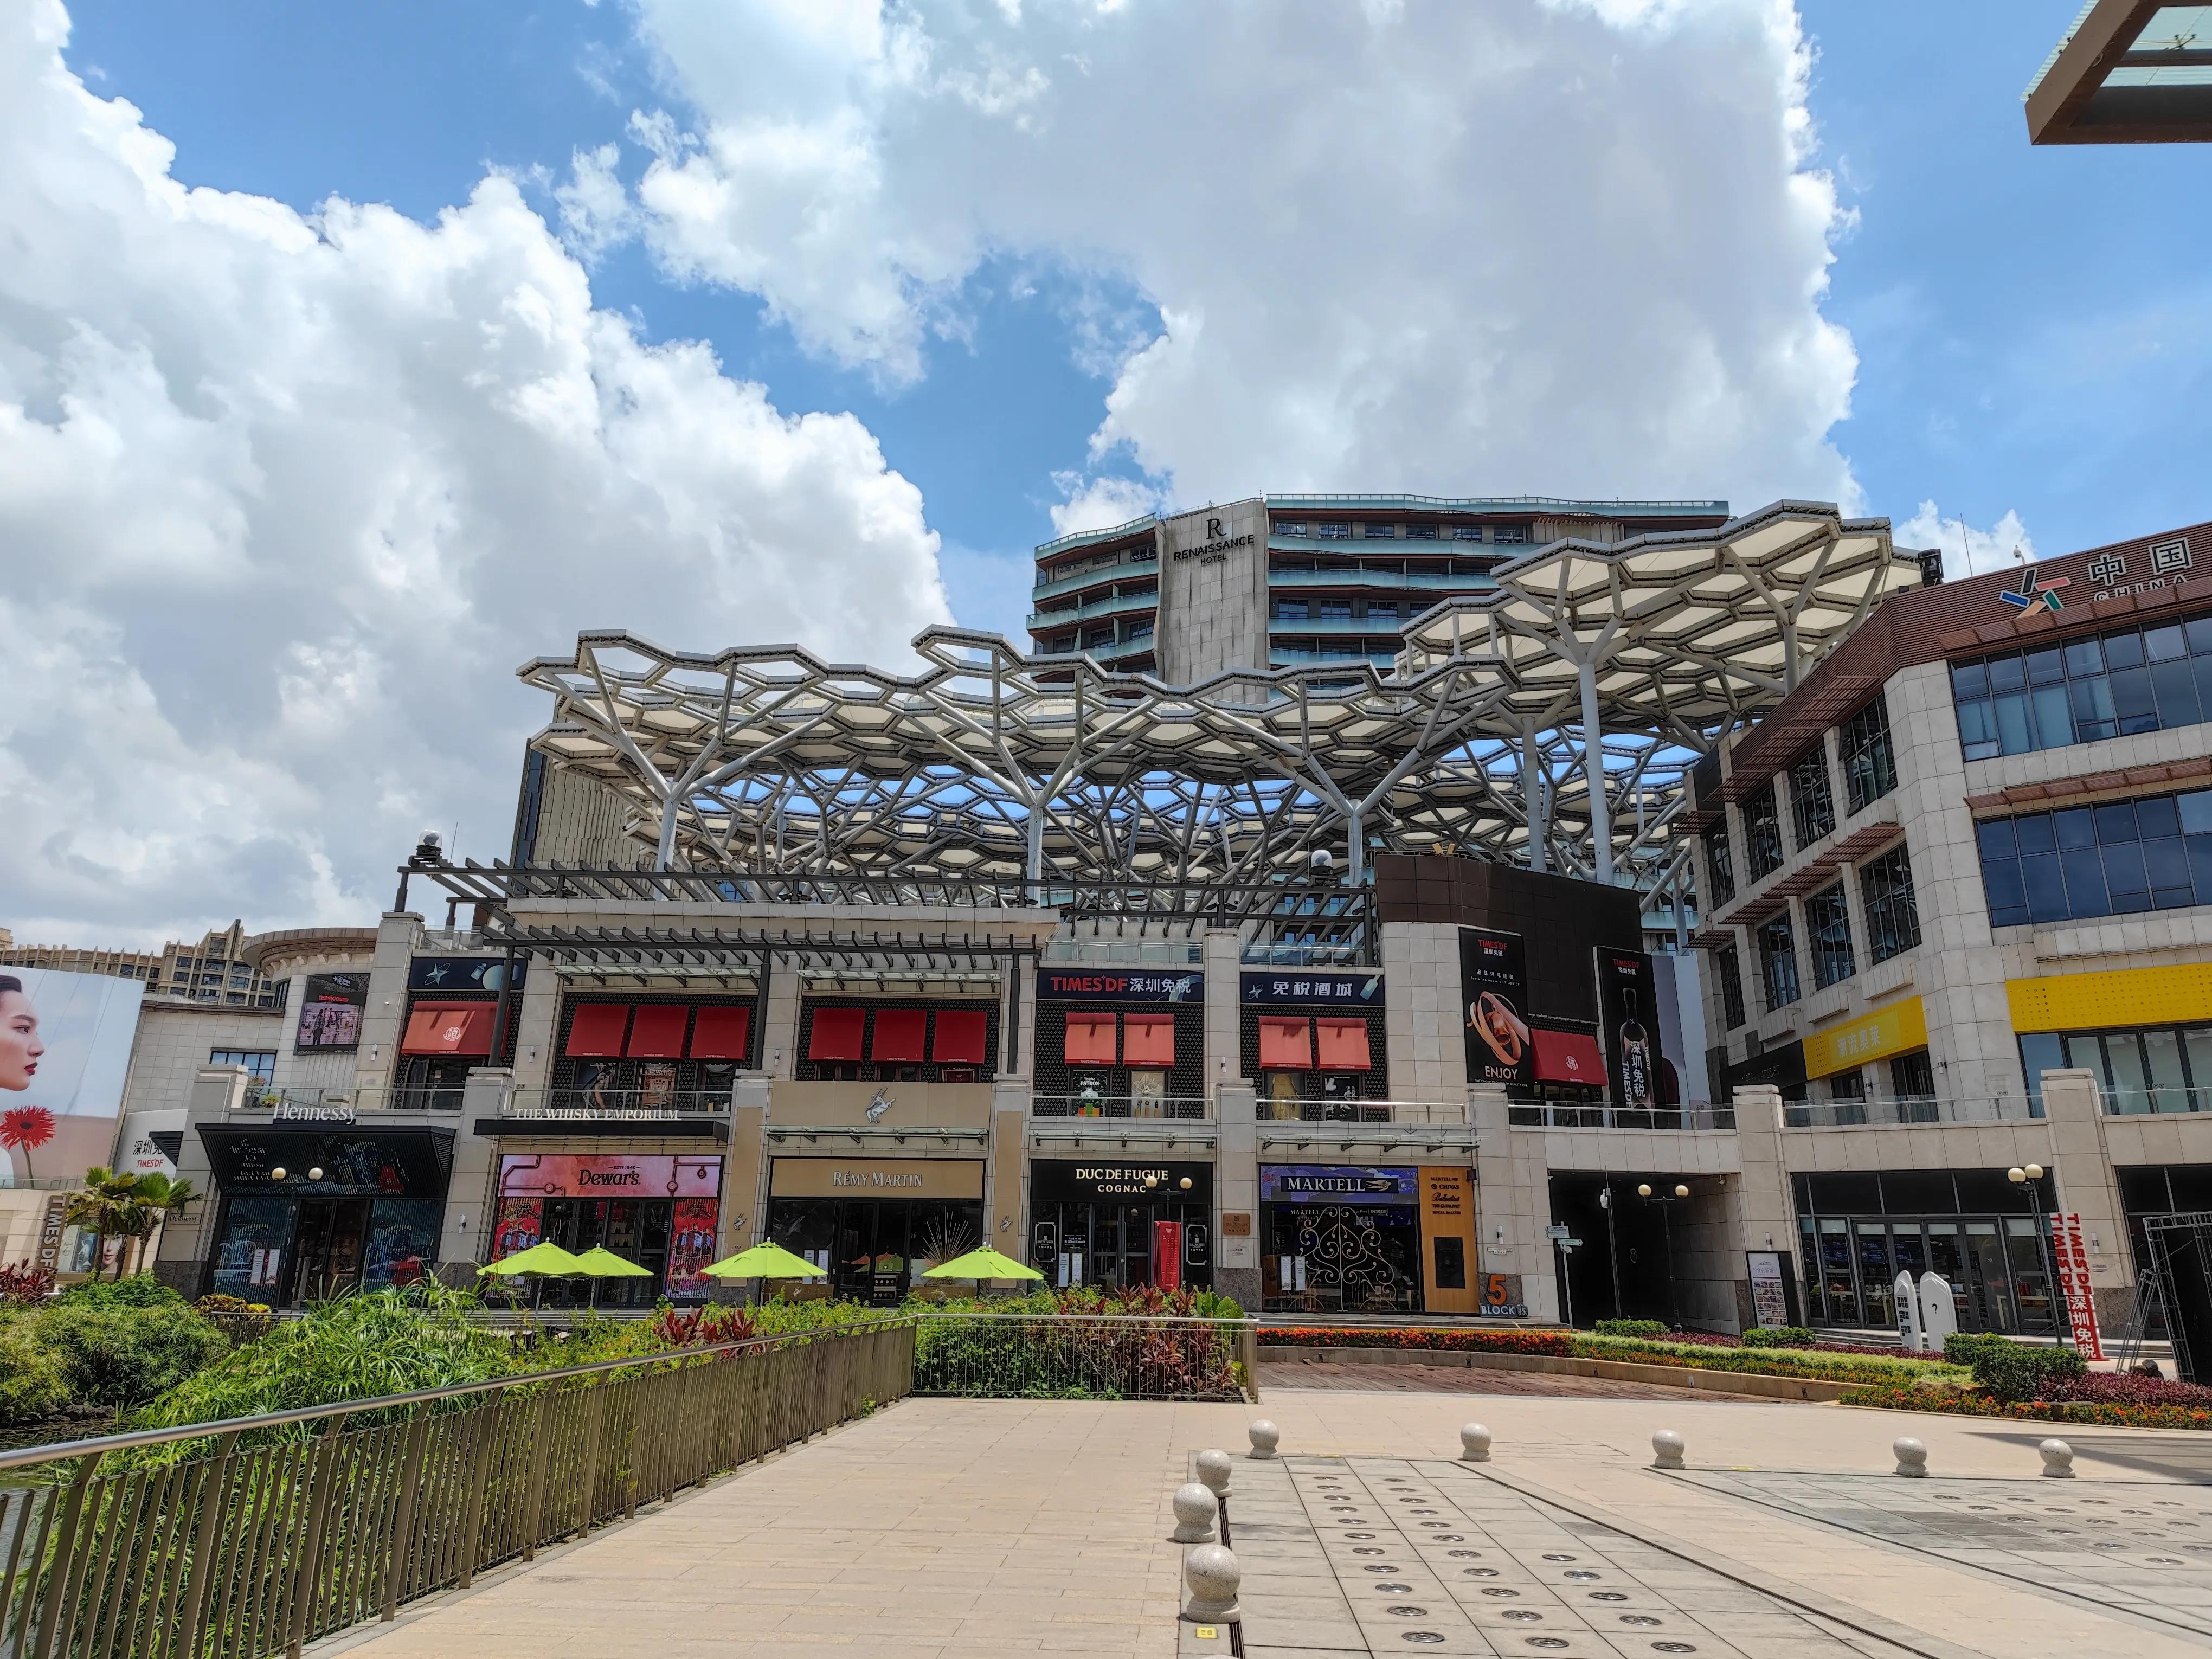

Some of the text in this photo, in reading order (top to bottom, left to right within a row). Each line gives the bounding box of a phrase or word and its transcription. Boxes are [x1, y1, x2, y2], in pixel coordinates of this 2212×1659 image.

[1206, 518, 1227, 539] R
[1174, 534, 1255, 561] RENAISSANCE
[1200, 554, 1227, 565] HOTEL
[2088, 537, 2193, 586] 中国
[2093, 574, 2187, 602] CHINA
[1129, 978, 1191, 993] 深圳免税
[1272, 981, 1352, 996] 免税酒城
[1484, 1065, 1517, 1080] ENJOY
[1630, 1041, 1645, 1097] 深圳免税
[273, 1102, 359, 1124] Hennessy
[515, 1109, 679, 1120] THE WHISKY EMPORIUM
[833, 1171, 923, 1187] RÉMY MARTIN
[1075, 1169, 1169, 1180] DUC DE FUGUE
[1098, 1185, 1146, 1193] COGNAC
[1288, 1178, 1366, 1191] MARTELL
[170, 1214, 197, 1223] Hennessy
[1486, 1274, 1507, 1306] 5
[1481, 1305, 1515, 1315] BLOCK
[2070, 1296, 2097, 1358] 深圳免税
